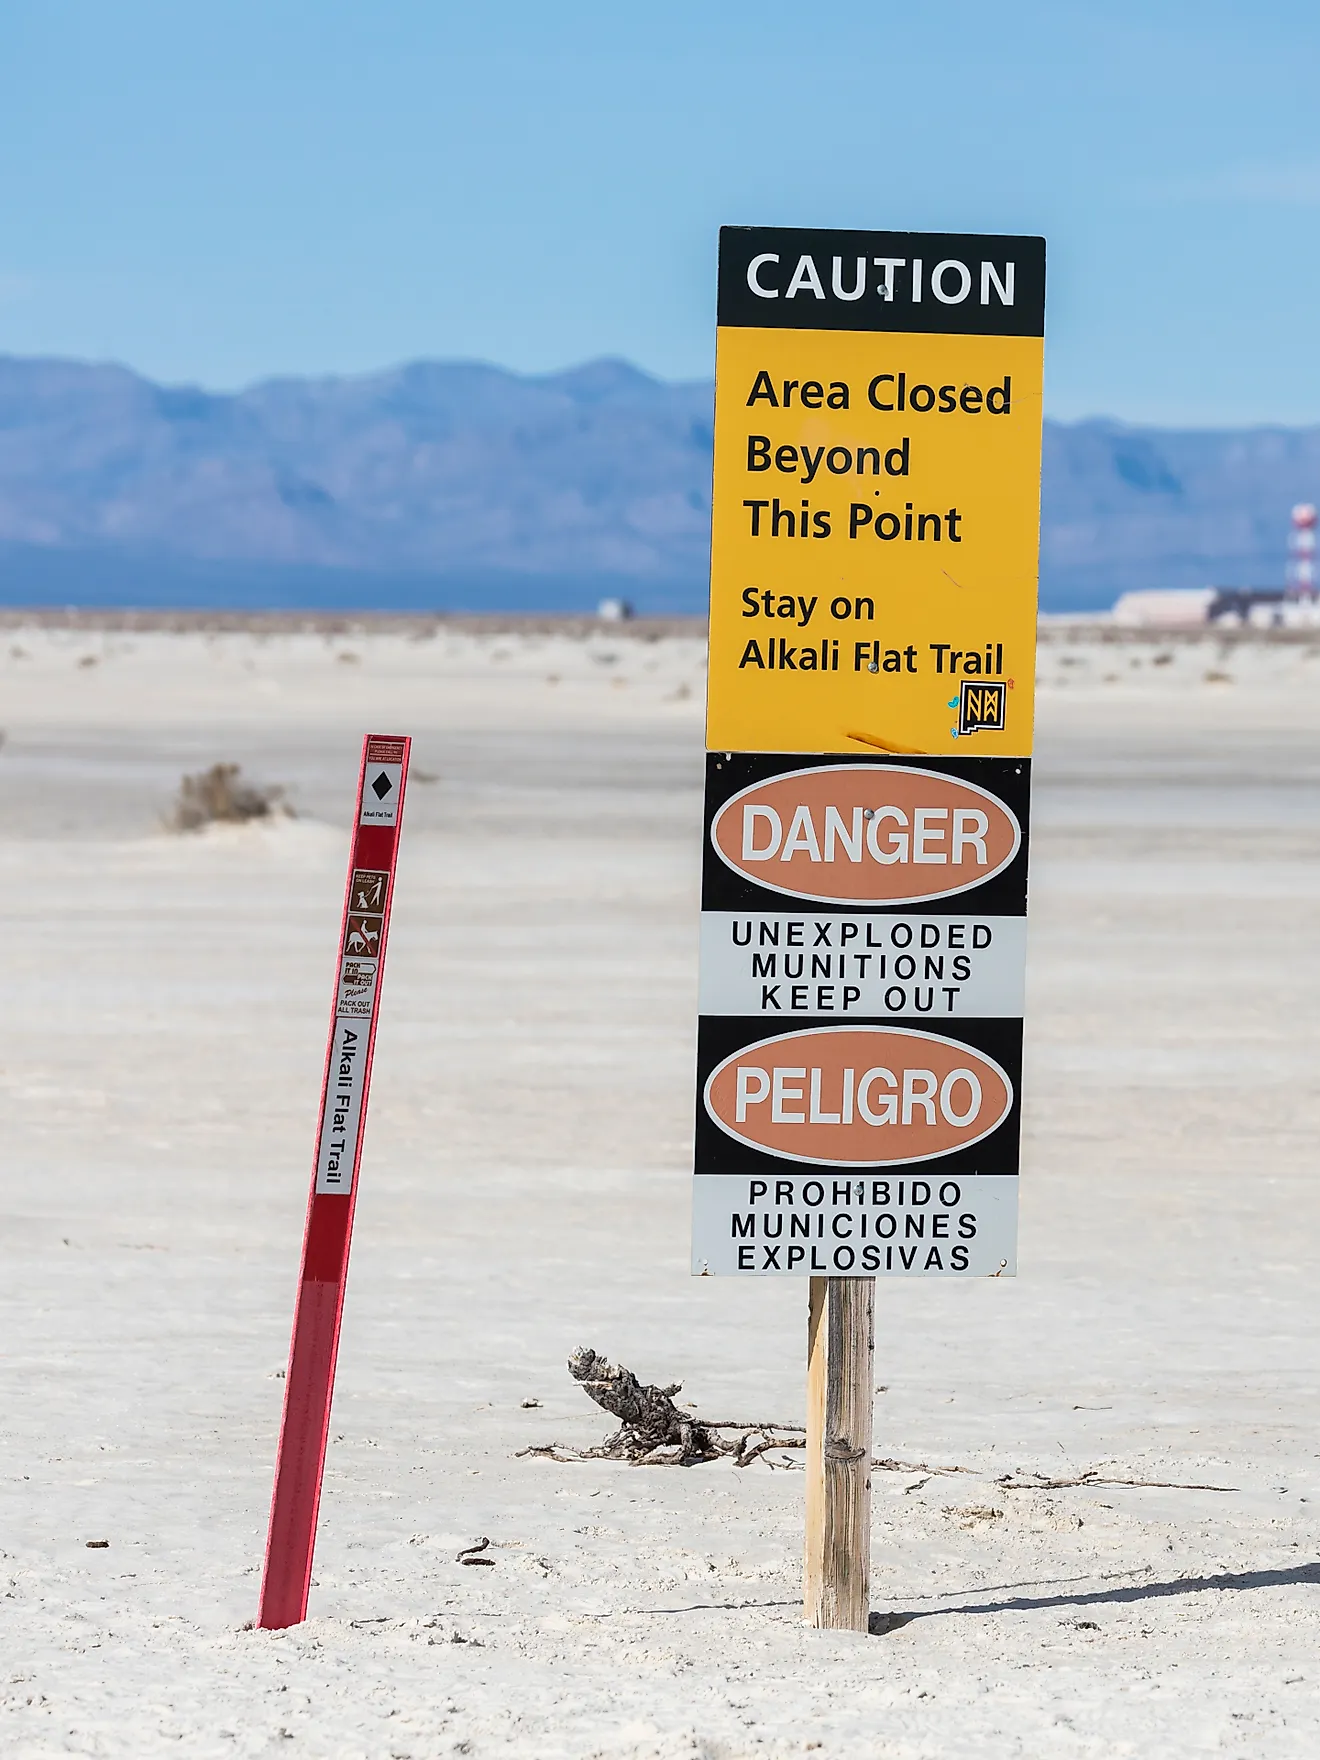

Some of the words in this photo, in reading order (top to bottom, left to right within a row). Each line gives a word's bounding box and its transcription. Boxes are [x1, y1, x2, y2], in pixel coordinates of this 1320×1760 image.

[746, 253, 1016, 306] CAUTION
[746, 371, 850, 409] Area
[867, 373, 1012, 414] Closed
[747, 435, 910, 484] Beyond
[743, 499, 831, 540] This
[849, 503, 962, 543] Point
[741, 588, 818, 627] Stay
[831, 594, 875, 621] on
[739, 638, 839, 672] Alkali
[855, 642, 917, 674] Flat
[930, 644, 1003, 675] Trail
[742, 804, 990, 867] DANGER
[731, 920, 993, 950] UNEXPLODED
[752, 953, 972, 981] MUNITIONS
[344, 987, 368, 998] Please
[761, 984, 861, 1011] KEEP
[884, 985, 961, 1012] OUT
[338, 1029, 358, 1087] Alkali
[332, 1095, 351, 1133] Flat
[735, 1066, 983, 1127] PELIGRO
[326, 1139, 346, 1183] Trail
[749, 1180, 962, 1208] PROHIBIDO
[731, 1212, 978, 1240] MUNICIONES
[738, 1244, 970, 1271] EXPLOSIVAS
